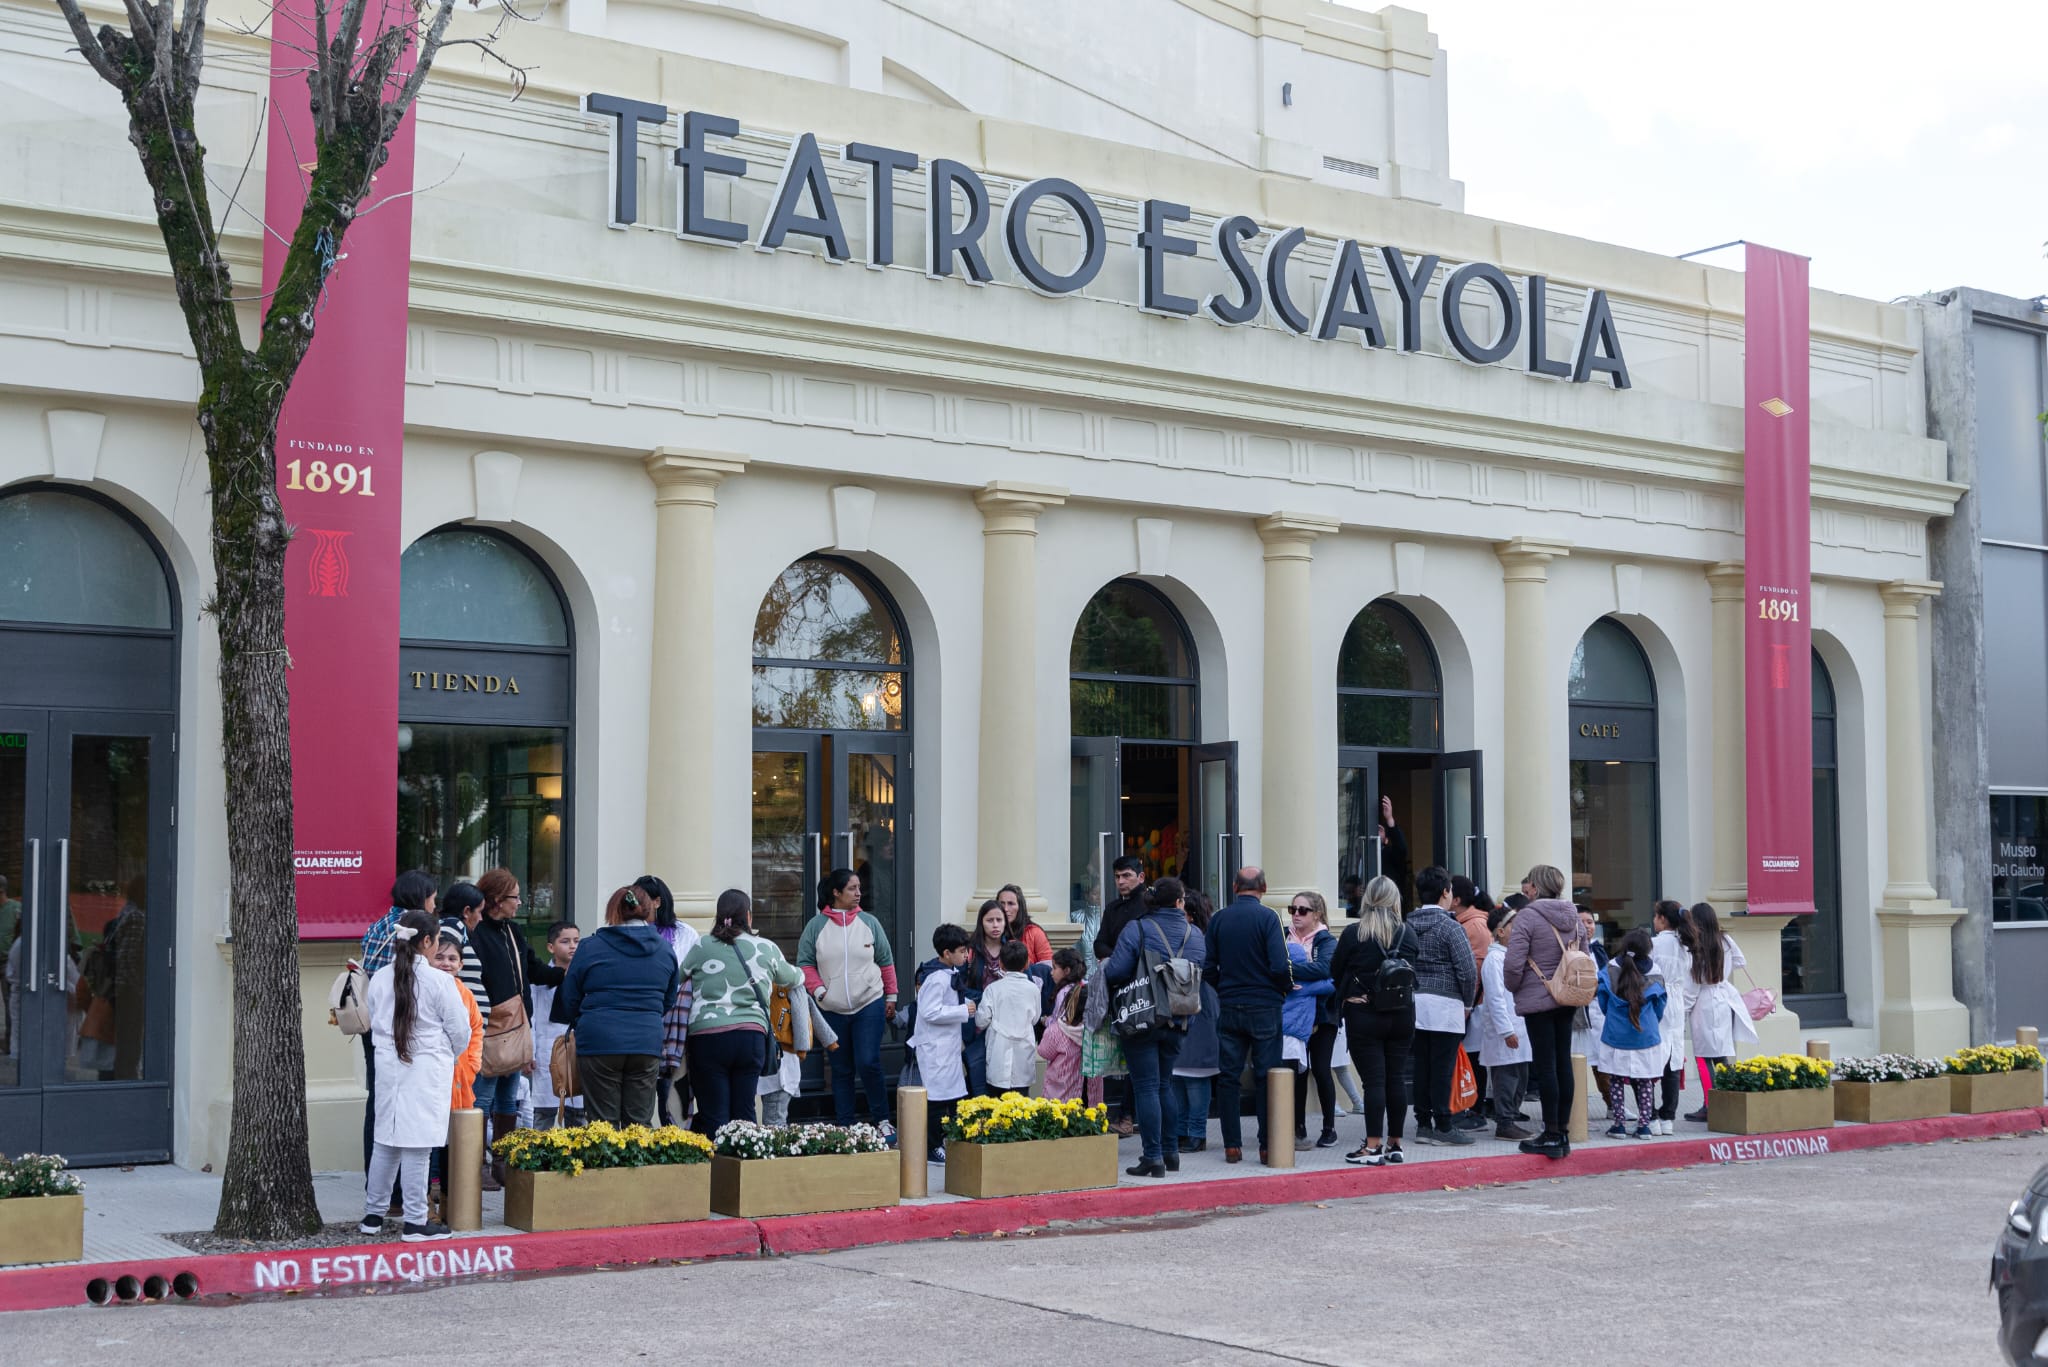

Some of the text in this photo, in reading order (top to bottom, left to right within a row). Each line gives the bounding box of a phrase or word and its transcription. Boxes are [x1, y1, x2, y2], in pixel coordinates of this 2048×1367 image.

[581, 92, 1631, 389] TEATRO ESCAYOLA
[290, 439, 374, 455] FUNDADO EN
[286, 458, 375, 496] 1891
[1758, 598, 1799, 622] 1891
[409, 671, 520, 694] TIENDA
[1580, 722, 1620, 738] CAFÉ
[2000, 842, 2036, 858] Museo
[294, 856, 362, 868] CUAREMBÓ
[1993, 863, 2045, 877] Del Gaucho
[1709, 1136, 1830, 1161] NO ESTACIONAR
[255, 1245, 515, 1288] NO ESTACIONAR
